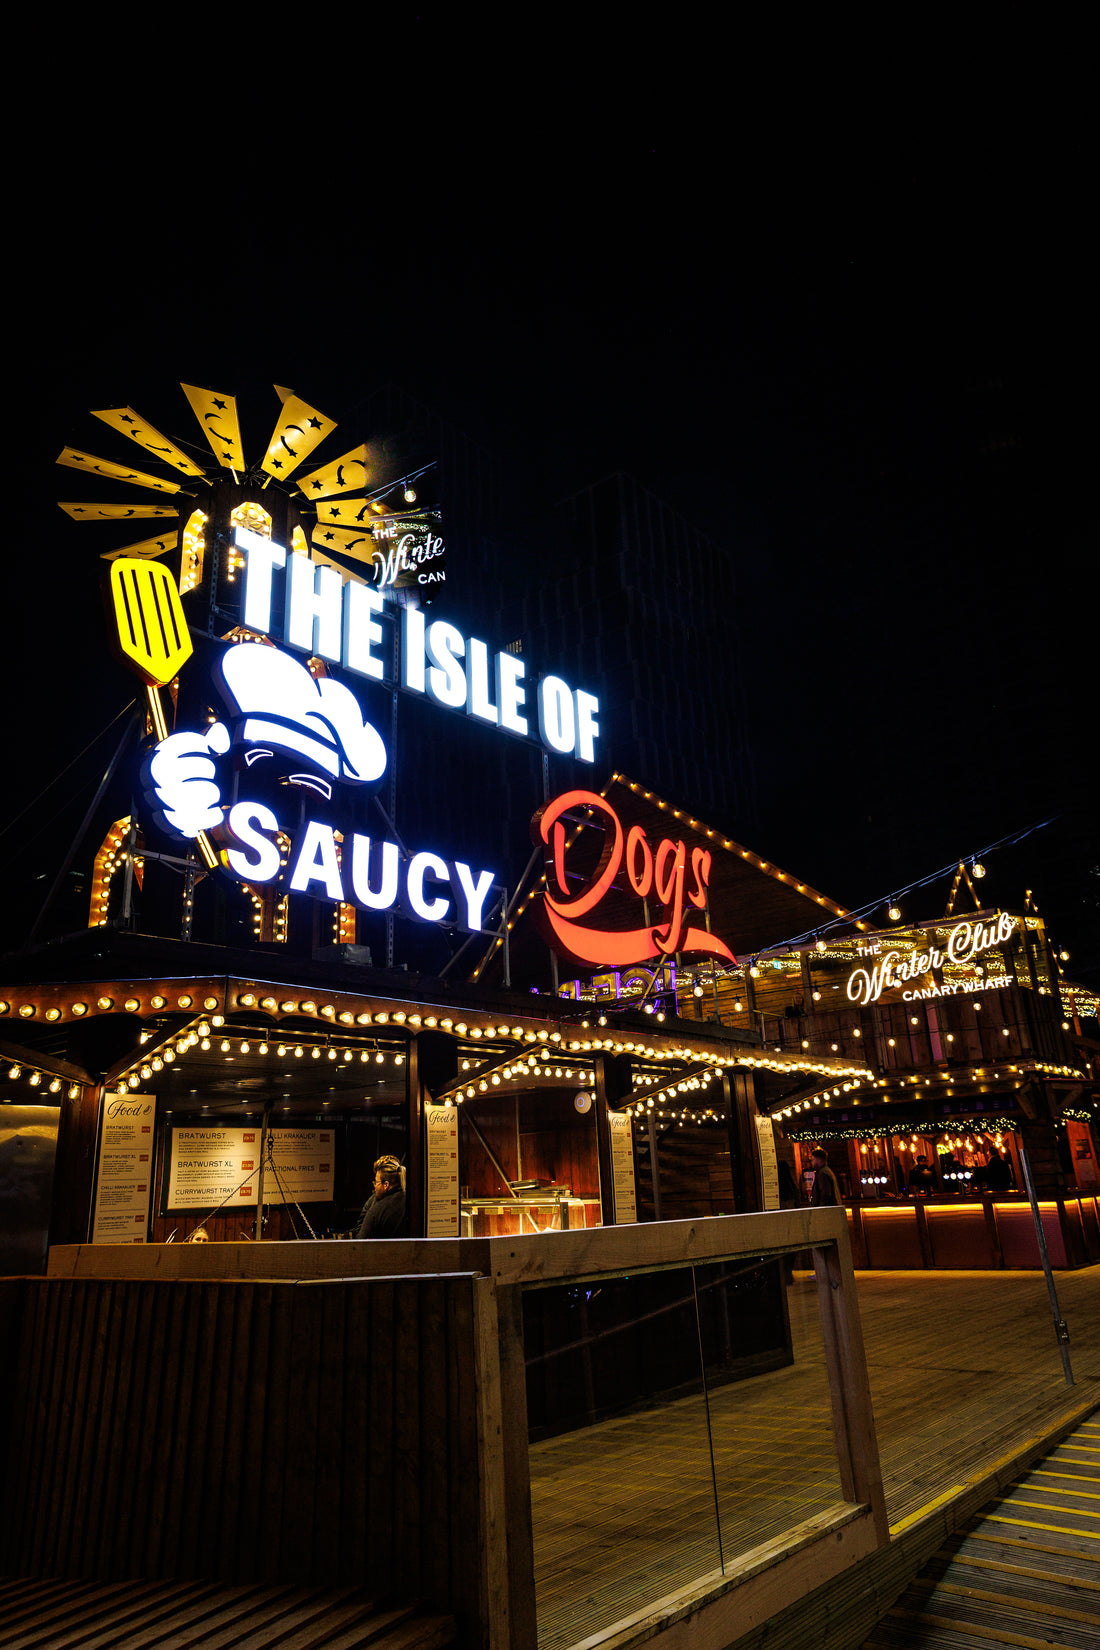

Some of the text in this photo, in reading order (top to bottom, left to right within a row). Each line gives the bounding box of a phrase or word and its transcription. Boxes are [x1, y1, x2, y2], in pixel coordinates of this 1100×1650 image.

[372, 528, 398, 540] THE
[417, 571, 446, 584] CAN
[234, 526, 600, 764] THE ISLE OF
[223, 800, 496, 932] SAUCY
[538, 789, 738, 966] Dogs
[846, 911, 1016, 1005] Winter Club
[856, 945, 882, 957] THE
[902, 975, 1014, 1001] CANARY WHARF
[107, 1099, 143, 1119] Food
[178, 1132, 226, 1140] BRATWURST
[177, 1160, 223, 1168] BRATWURST
